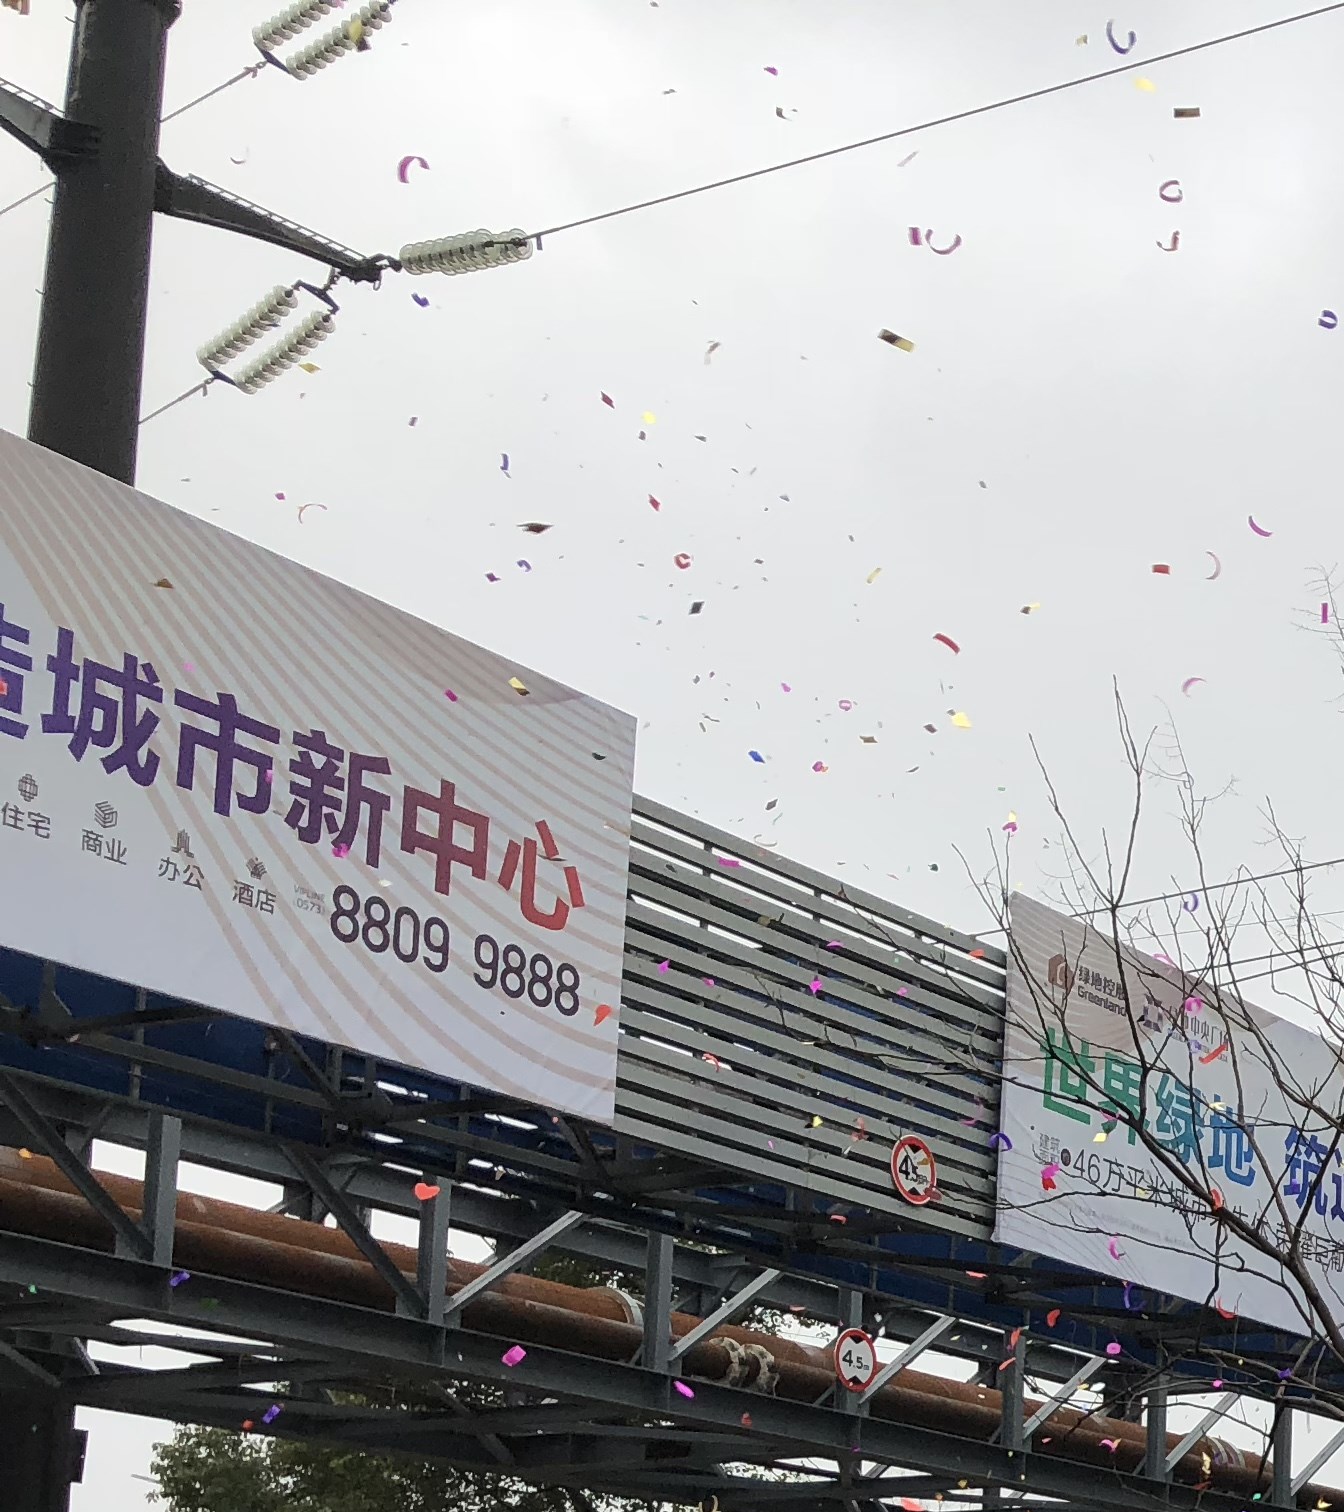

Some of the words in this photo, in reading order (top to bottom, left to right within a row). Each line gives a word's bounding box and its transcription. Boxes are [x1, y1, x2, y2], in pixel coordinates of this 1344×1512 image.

[0, 604, 586, 932] 城市新中心
[1, 802, 51, 840] 住宅
[81, 828, 128, 866] 商业
[158, 856, 205, 891] 办公
[232, 879, 278, 915] 酒店
[330, 884, 451, 973] 8809
[473, 933, 581, 1017] 9888
[1077, 984, 1128, 1018] Greenland
[1039, 1026, 1257, 1190] 世界绿地
[842, 1349, 870, 1371] 4.5m
